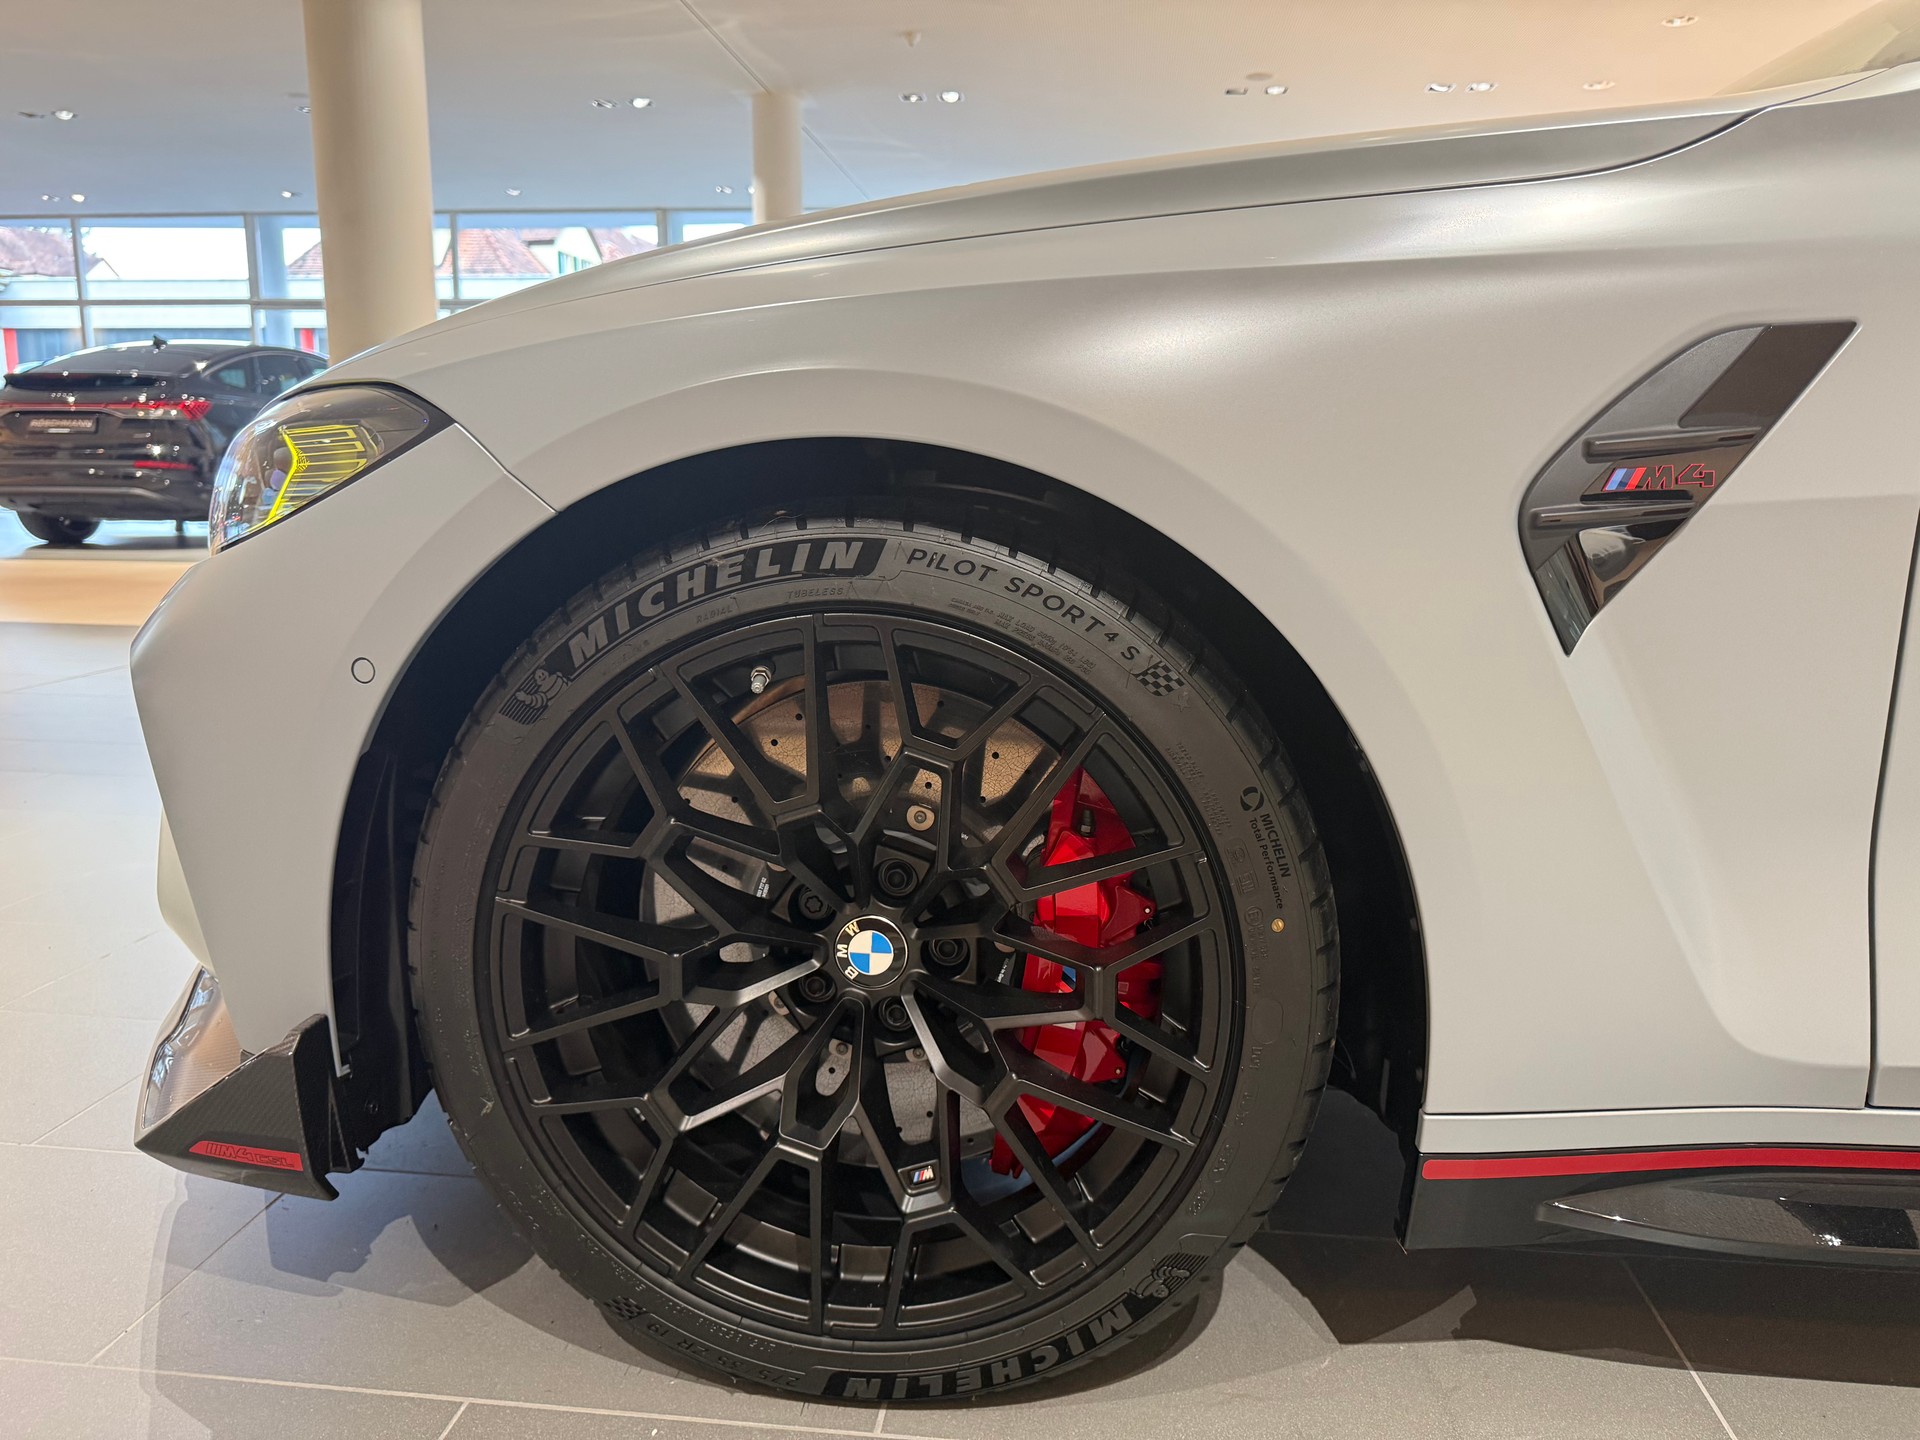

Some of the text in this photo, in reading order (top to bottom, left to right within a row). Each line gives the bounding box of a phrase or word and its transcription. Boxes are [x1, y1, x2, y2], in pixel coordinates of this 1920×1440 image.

[568, 541, 864, 668] MICHELIN
[906, 548, 998, 582] PILOT
[1004, 576, 1106, 633] SPORT
[1103, 631, 1120, 643] 4
[1120, 645, 1141, 661] S
[1249, 817, 1284, 910] Total Performance
[1260, 813, 1291, 878] MICHELIN
[836, 921, 861, 981] BMW
[844, 1302, 1134, 1399] MICHELIN
